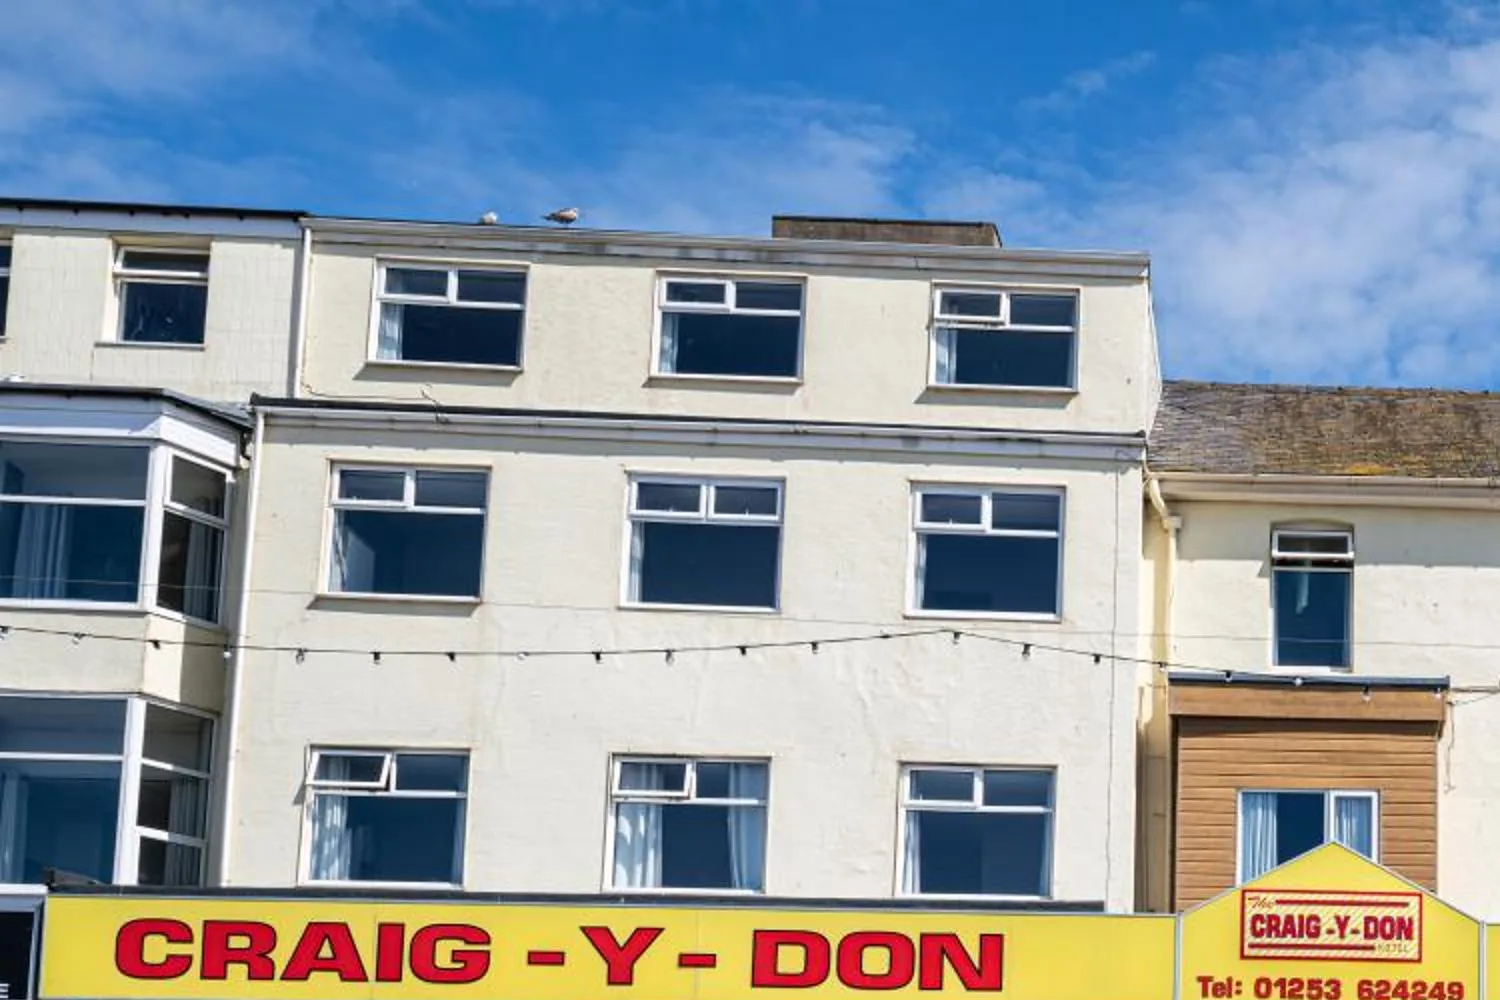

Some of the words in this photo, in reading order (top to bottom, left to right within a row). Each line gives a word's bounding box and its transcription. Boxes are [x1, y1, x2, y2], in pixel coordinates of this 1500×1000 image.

[1250, 912, 1321, 939] CRAIG
[1363, 915, 1414, 941] DON
[114, 917, 492, 985] CRAIG
[750, 929, 1005, 993] DON
[1196, 975, 1243, 999] Tel:
